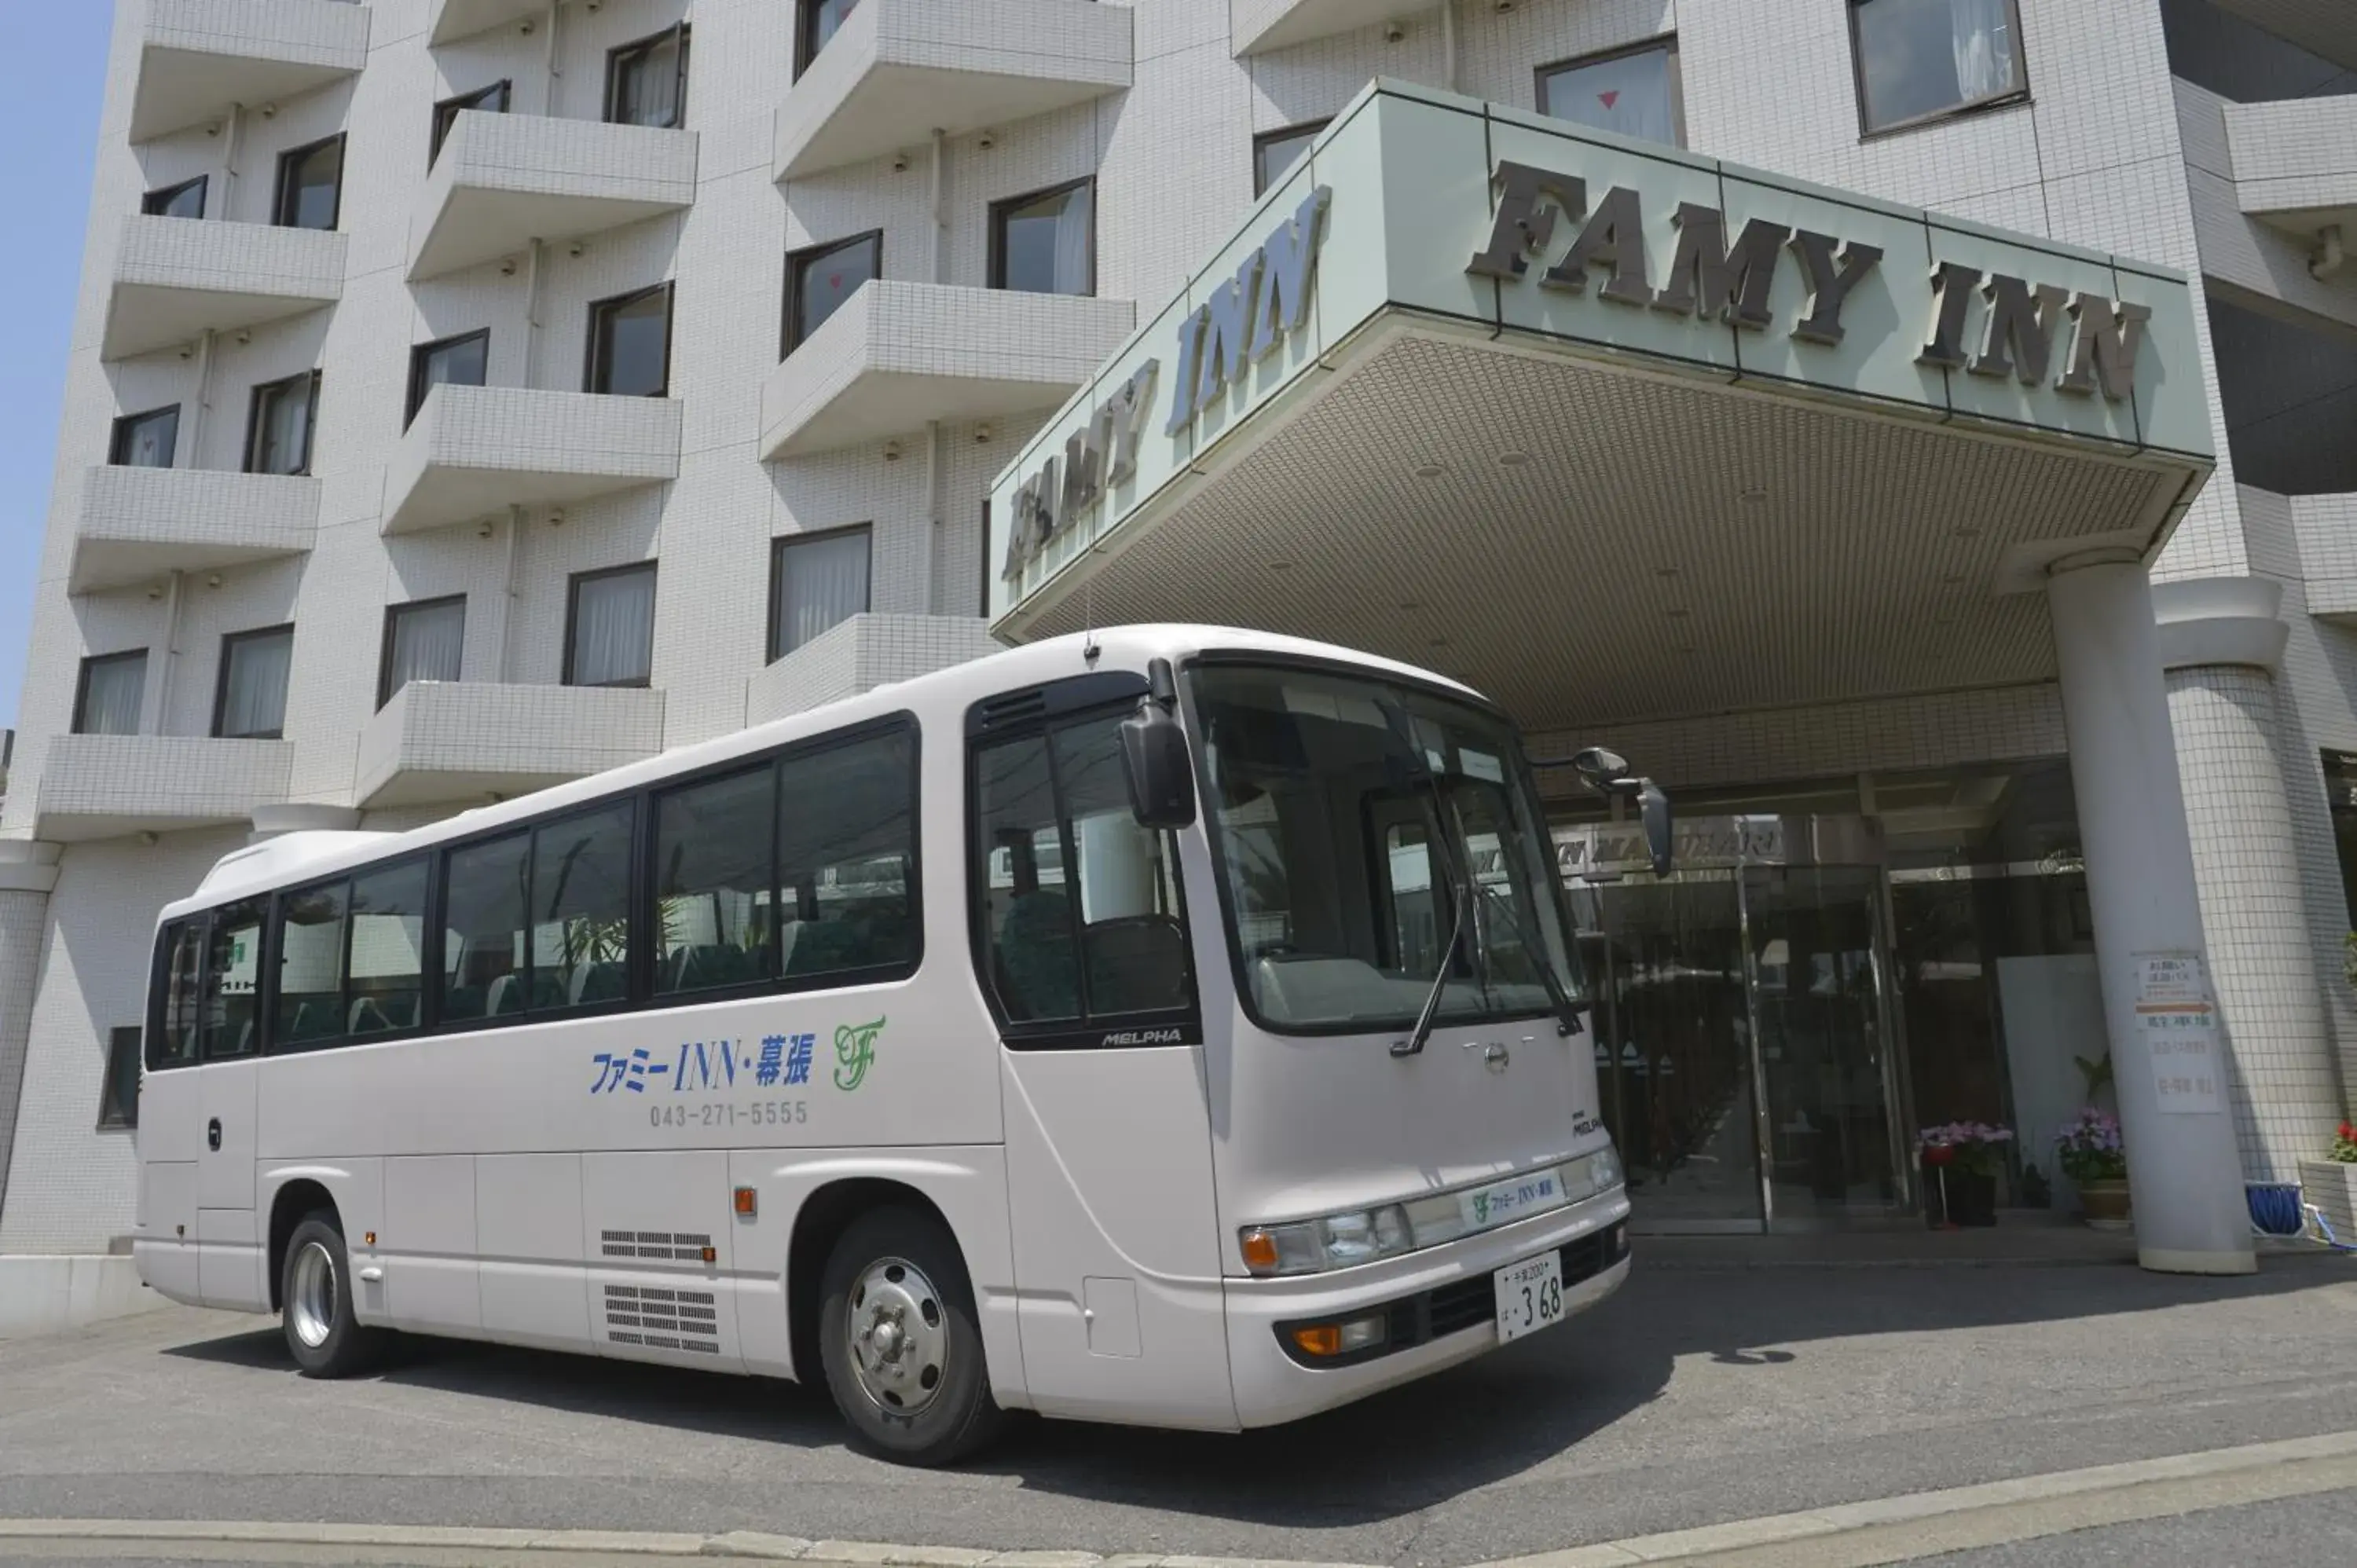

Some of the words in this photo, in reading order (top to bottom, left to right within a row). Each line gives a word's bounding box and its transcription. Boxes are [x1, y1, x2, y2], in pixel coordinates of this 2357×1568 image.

[1468, 159, 1883, 346] FAMY
[1915, 260, 2151, 402] INN
[1002, 358, 1158, 581] FAMY
[1165, 185, 1332, 438] INN
[1102, 1028, 1182, 1046] MELPHA
[651, 1101, 808, 1127] 043-271-5555
